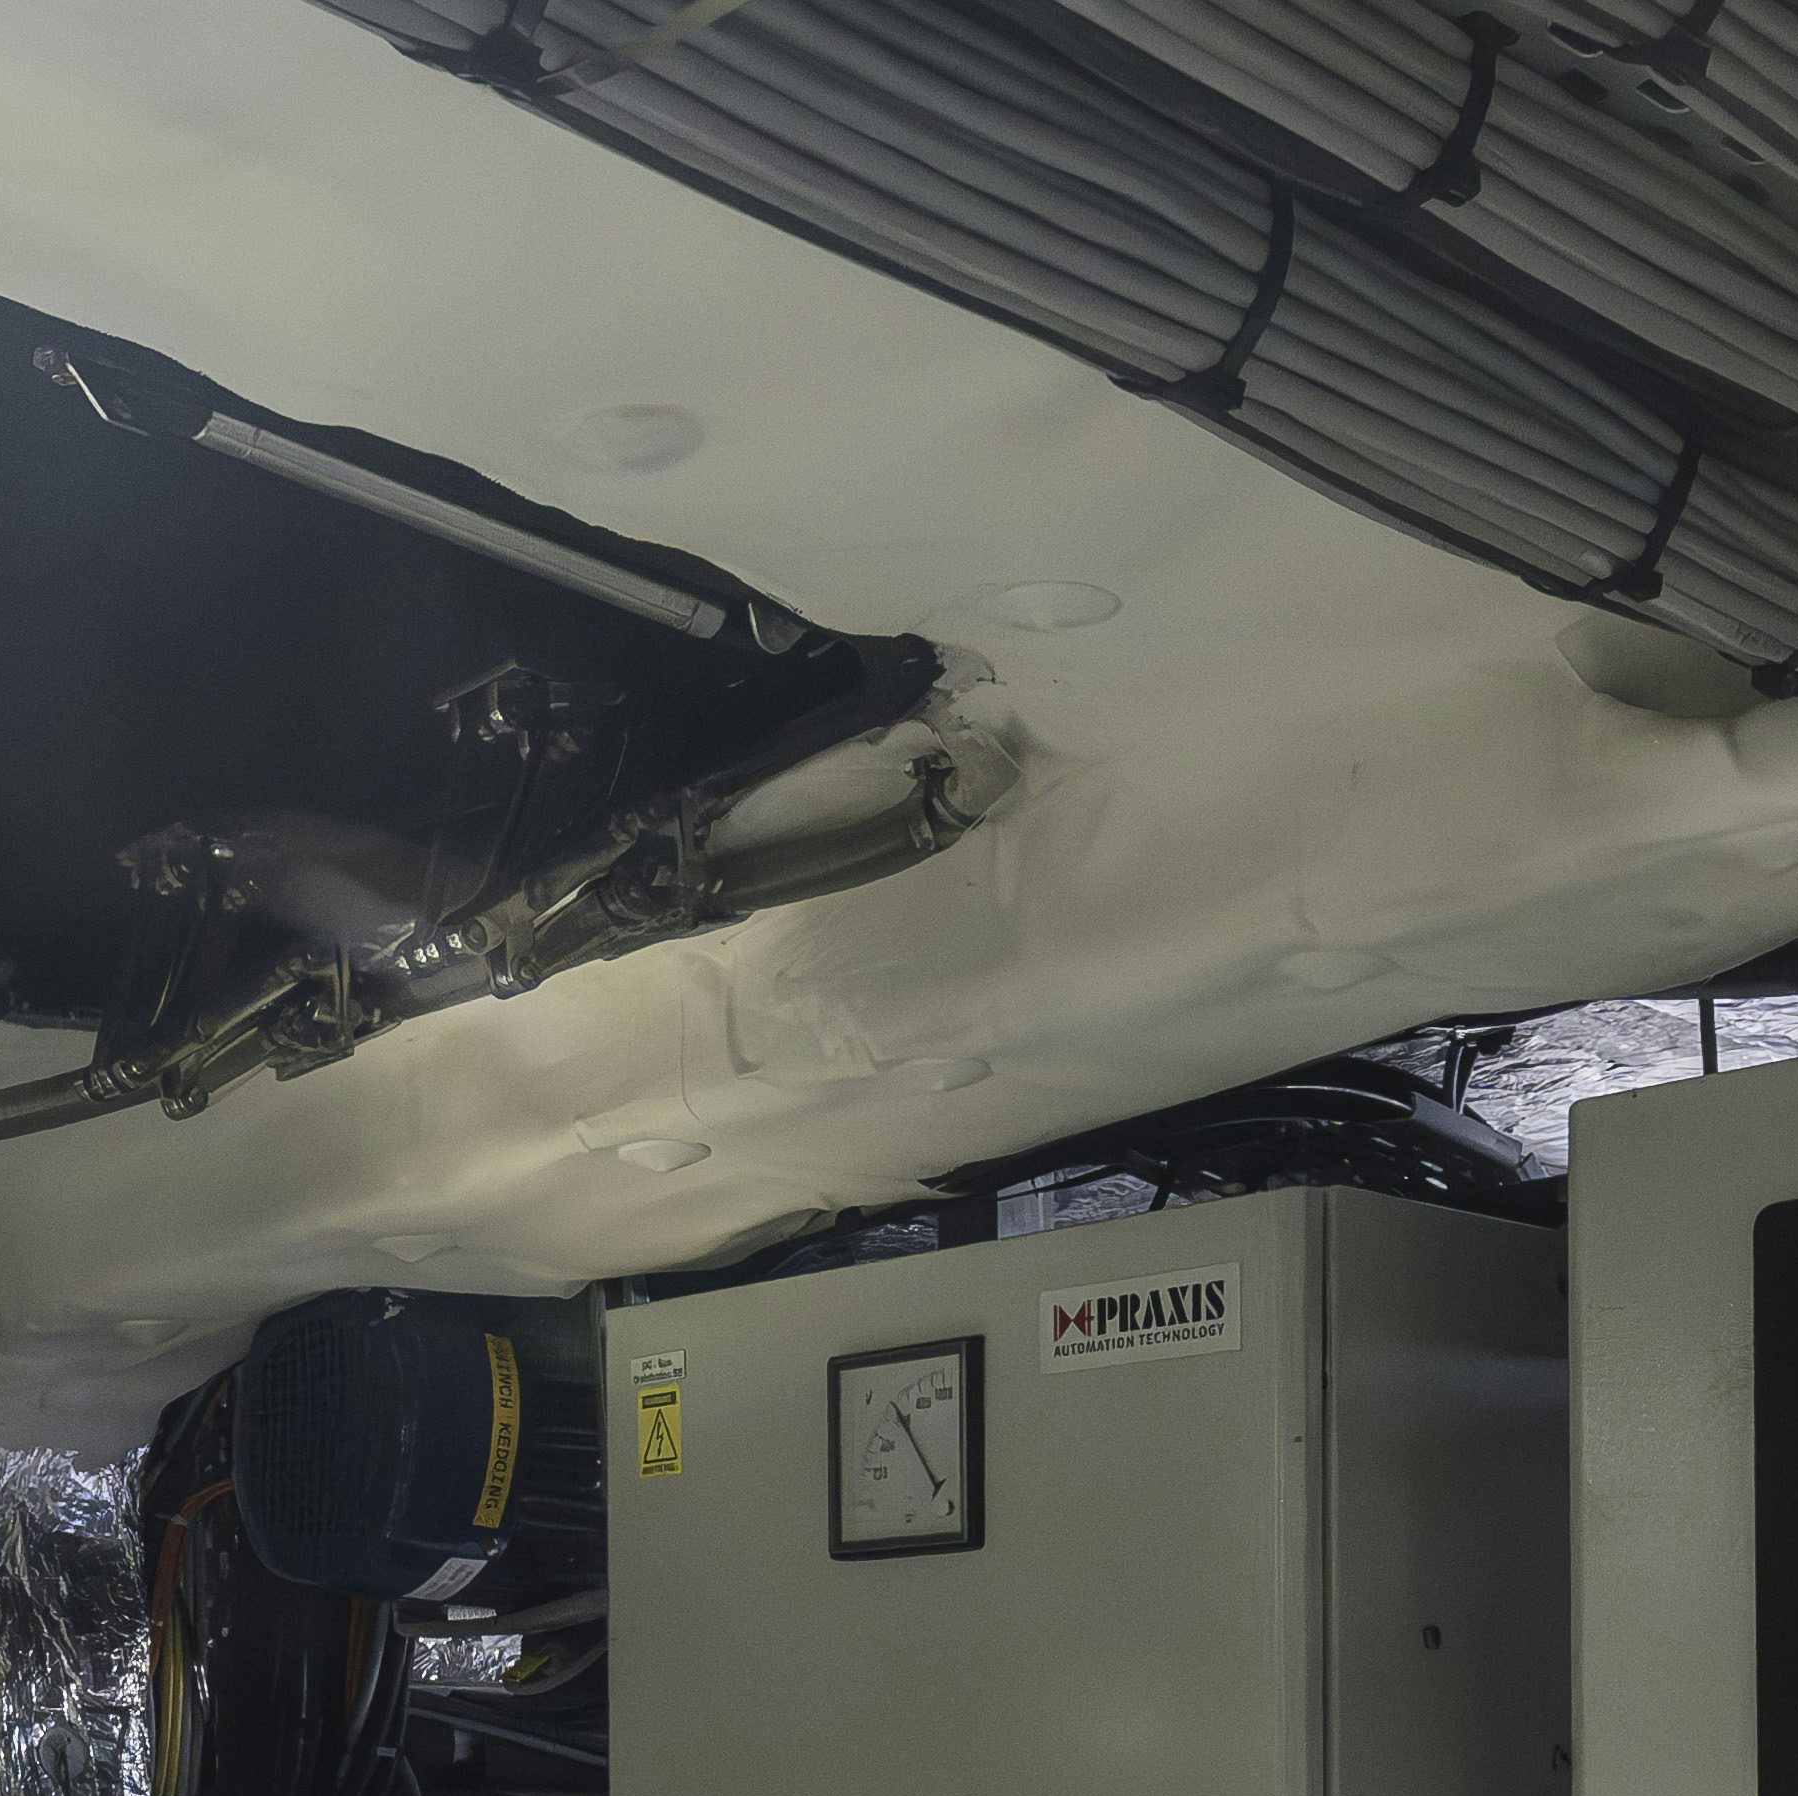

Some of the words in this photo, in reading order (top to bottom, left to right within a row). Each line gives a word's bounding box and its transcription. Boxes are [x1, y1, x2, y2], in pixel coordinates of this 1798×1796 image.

[1097, 1280, 1224, 1336] PRAXIS
[1054, 1335, 1134, 1358] AUTOMATION
[1140, 1323, 1224, 1345] TECHNOLOGY
